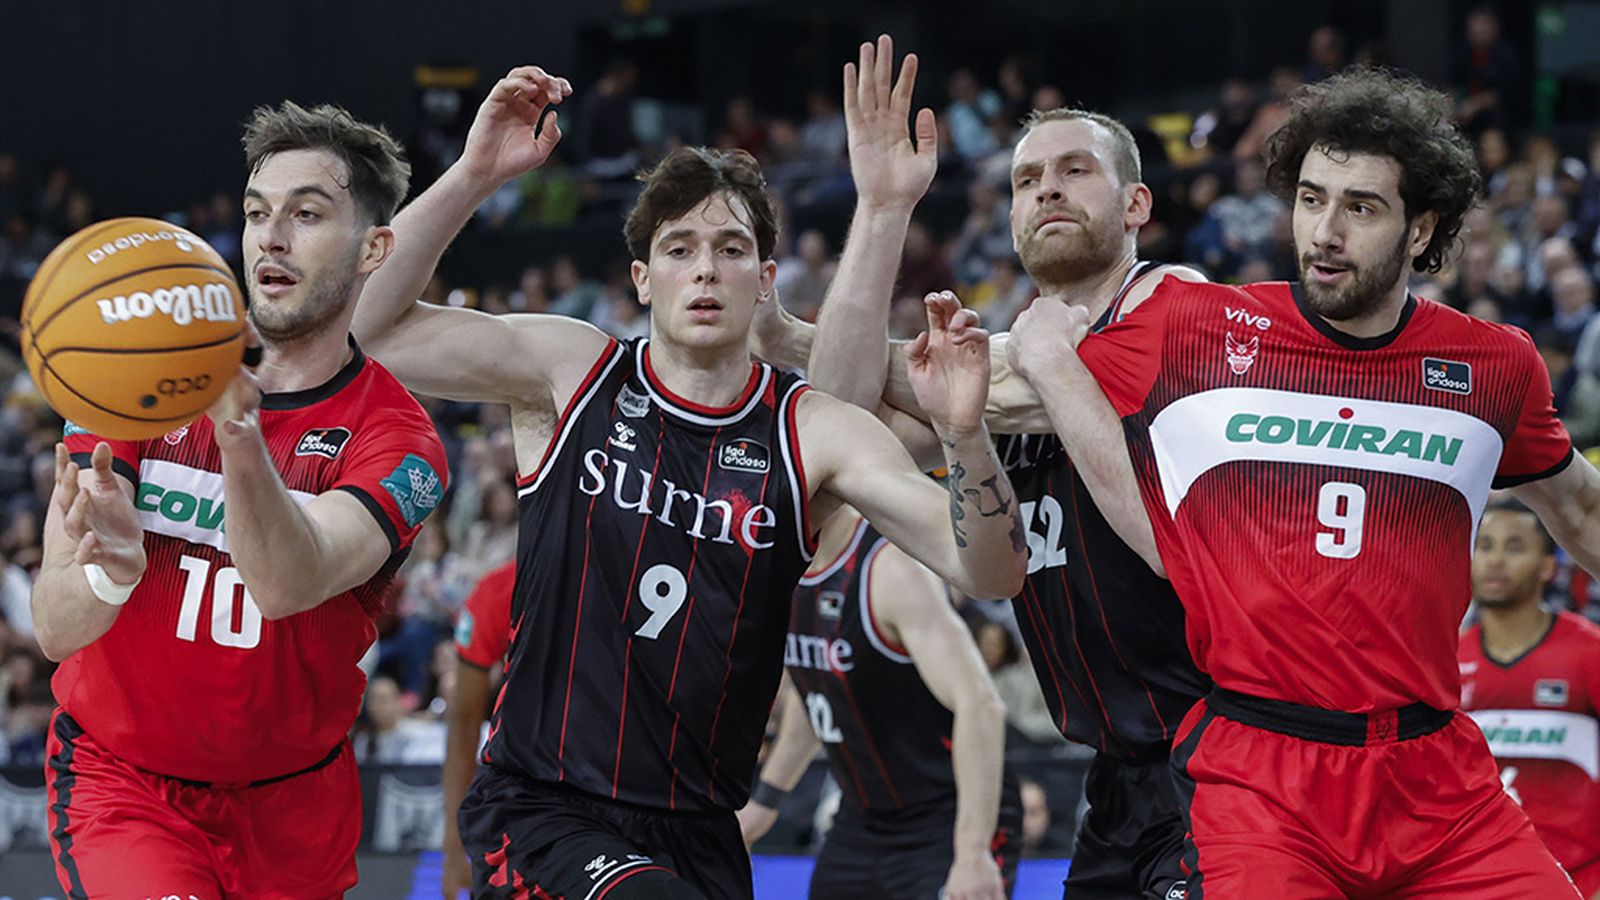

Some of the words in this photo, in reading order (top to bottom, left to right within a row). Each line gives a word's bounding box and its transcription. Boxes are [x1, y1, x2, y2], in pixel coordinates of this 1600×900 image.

[96, 283, 237, 325] Wilson
[1224, 306, 1271, 331] vive
[1225, 407, 1464, 467] COVIRAN
[134, 482, 226, 534] COV
[578, 448, 777, 550] surne
[1314, 481, 1367, 560] 9
[176, 554, 262, 649] 10
[634, 563, 688, 640] 9
[784, 632, 854, 673] urne
